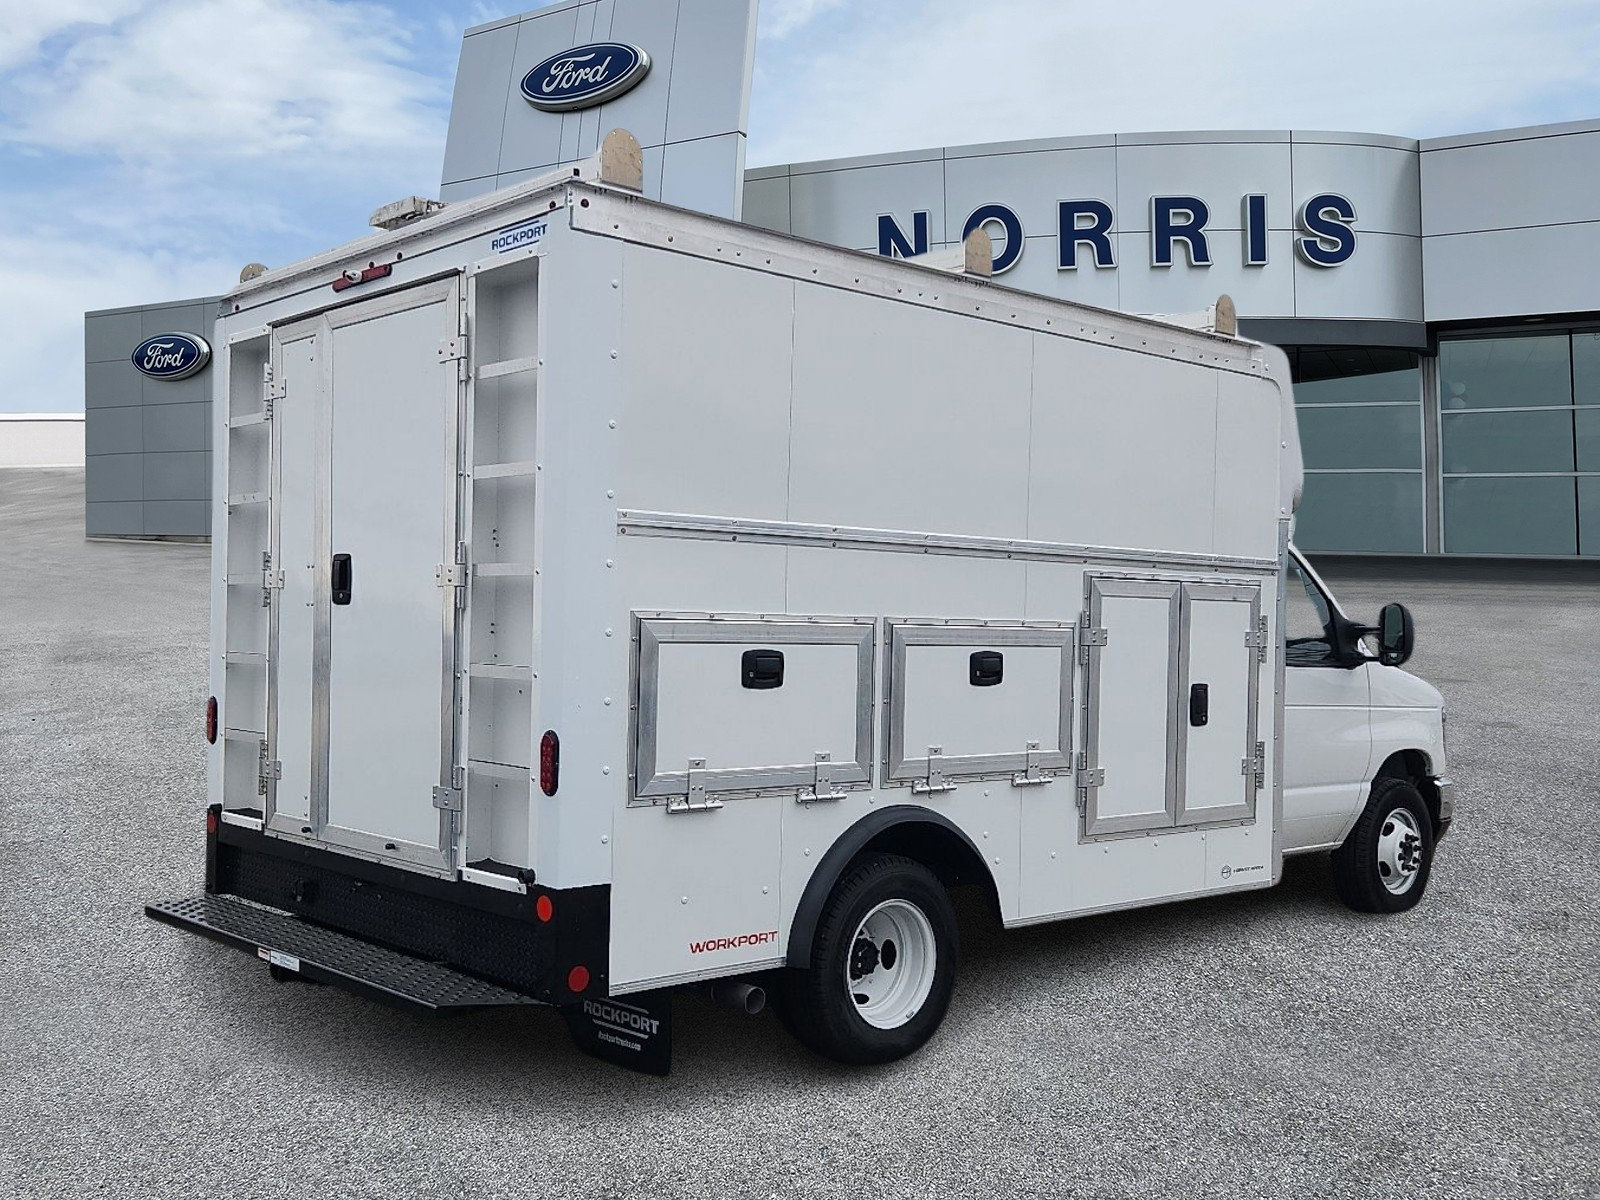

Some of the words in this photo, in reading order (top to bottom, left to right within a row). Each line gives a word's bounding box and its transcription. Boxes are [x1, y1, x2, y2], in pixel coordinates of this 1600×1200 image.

[542, 53, 612, 93] Ford
[492, 224, 548, 250] ROCKPORT
[876, 192, 1358, 275] NORRIS
[143, 343, 185, 369] Ford
[690, 931, 778, 953] WORKPORT
[583, 1000, 659, 1034] ROCKPORT
